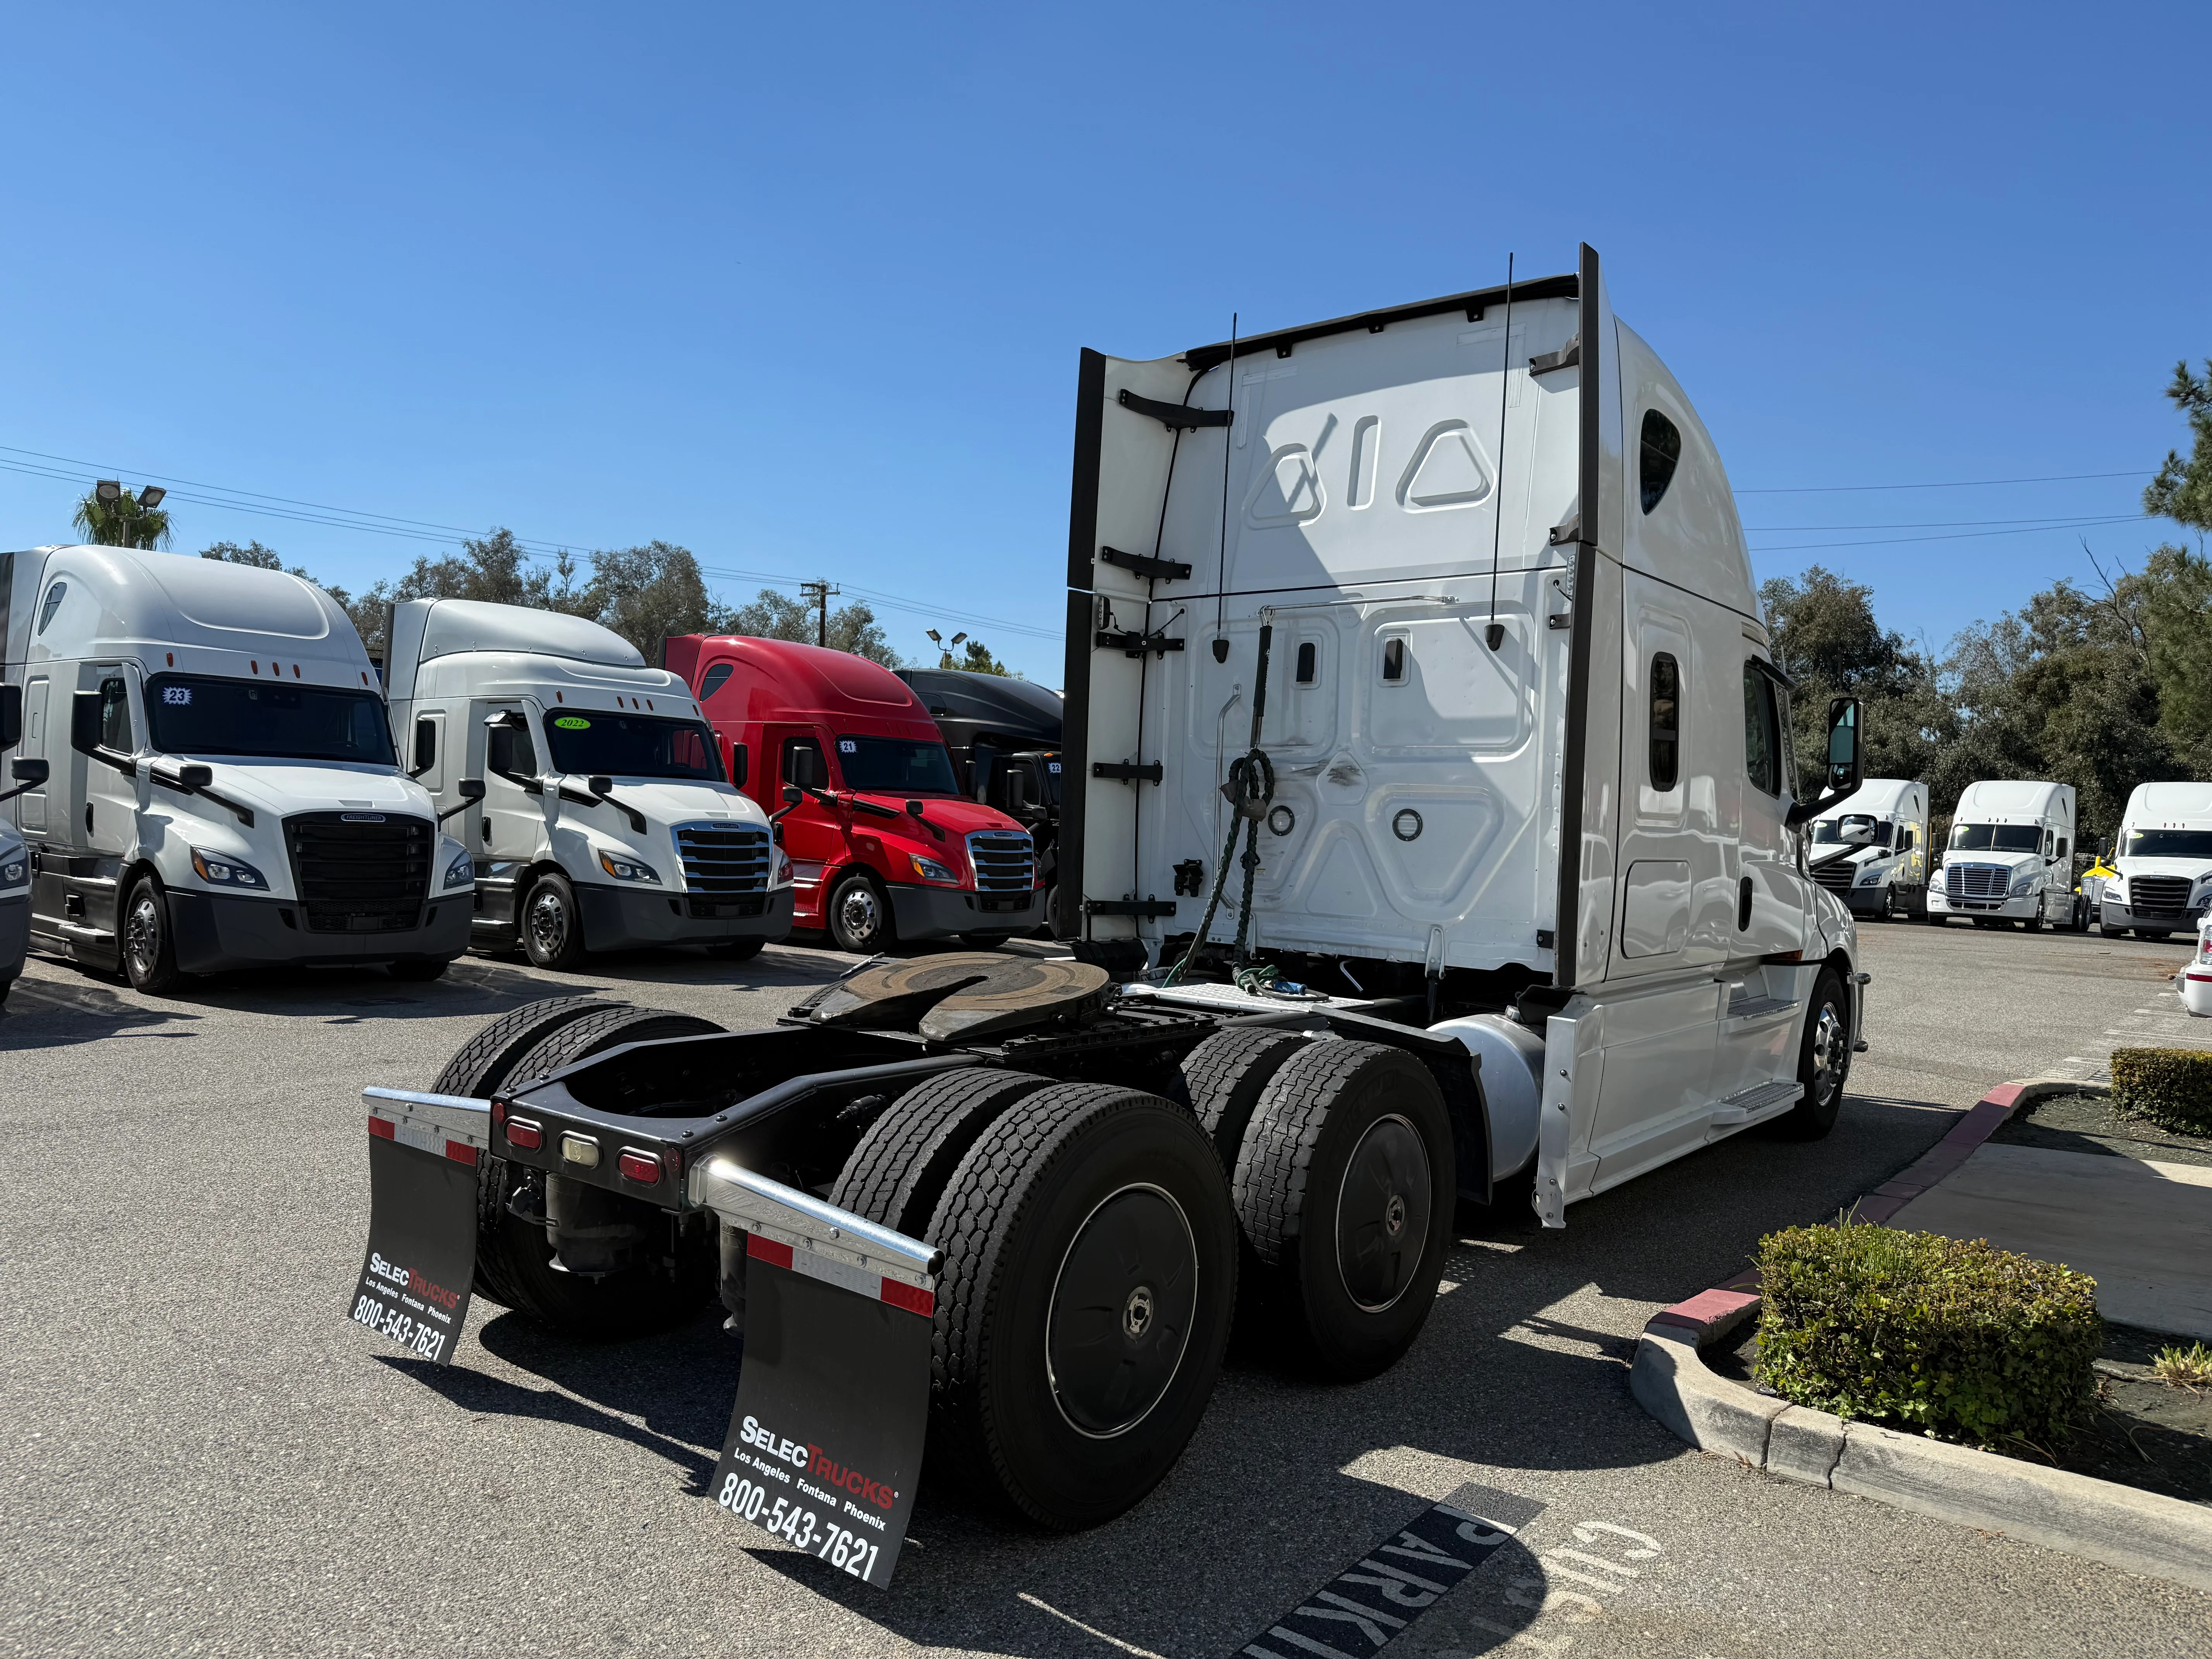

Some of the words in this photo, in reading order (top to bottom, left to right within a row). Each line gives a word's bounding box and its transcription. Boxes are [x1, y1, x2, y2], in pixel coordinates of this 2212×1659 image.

[169, 690, 184, 701] 23
[354, 1295, 446, 1361] 800-543-7621
[366, 1276, 376, 1288] Los
[376, 1282, 398, 1298] Angeles
[402, 1293, 424, 1311] Fontana
[428, 1306, 452, 1324] Phoenix
[734, 1447, 751, 1464] Los
[752, 1457, 790, 1483] Angeles
[797, 1478, 837, 1506] Fontana
[843, 1501, 886, 1531] Phoenix
[719, 1472, 879, 1582] 800-543-7621
